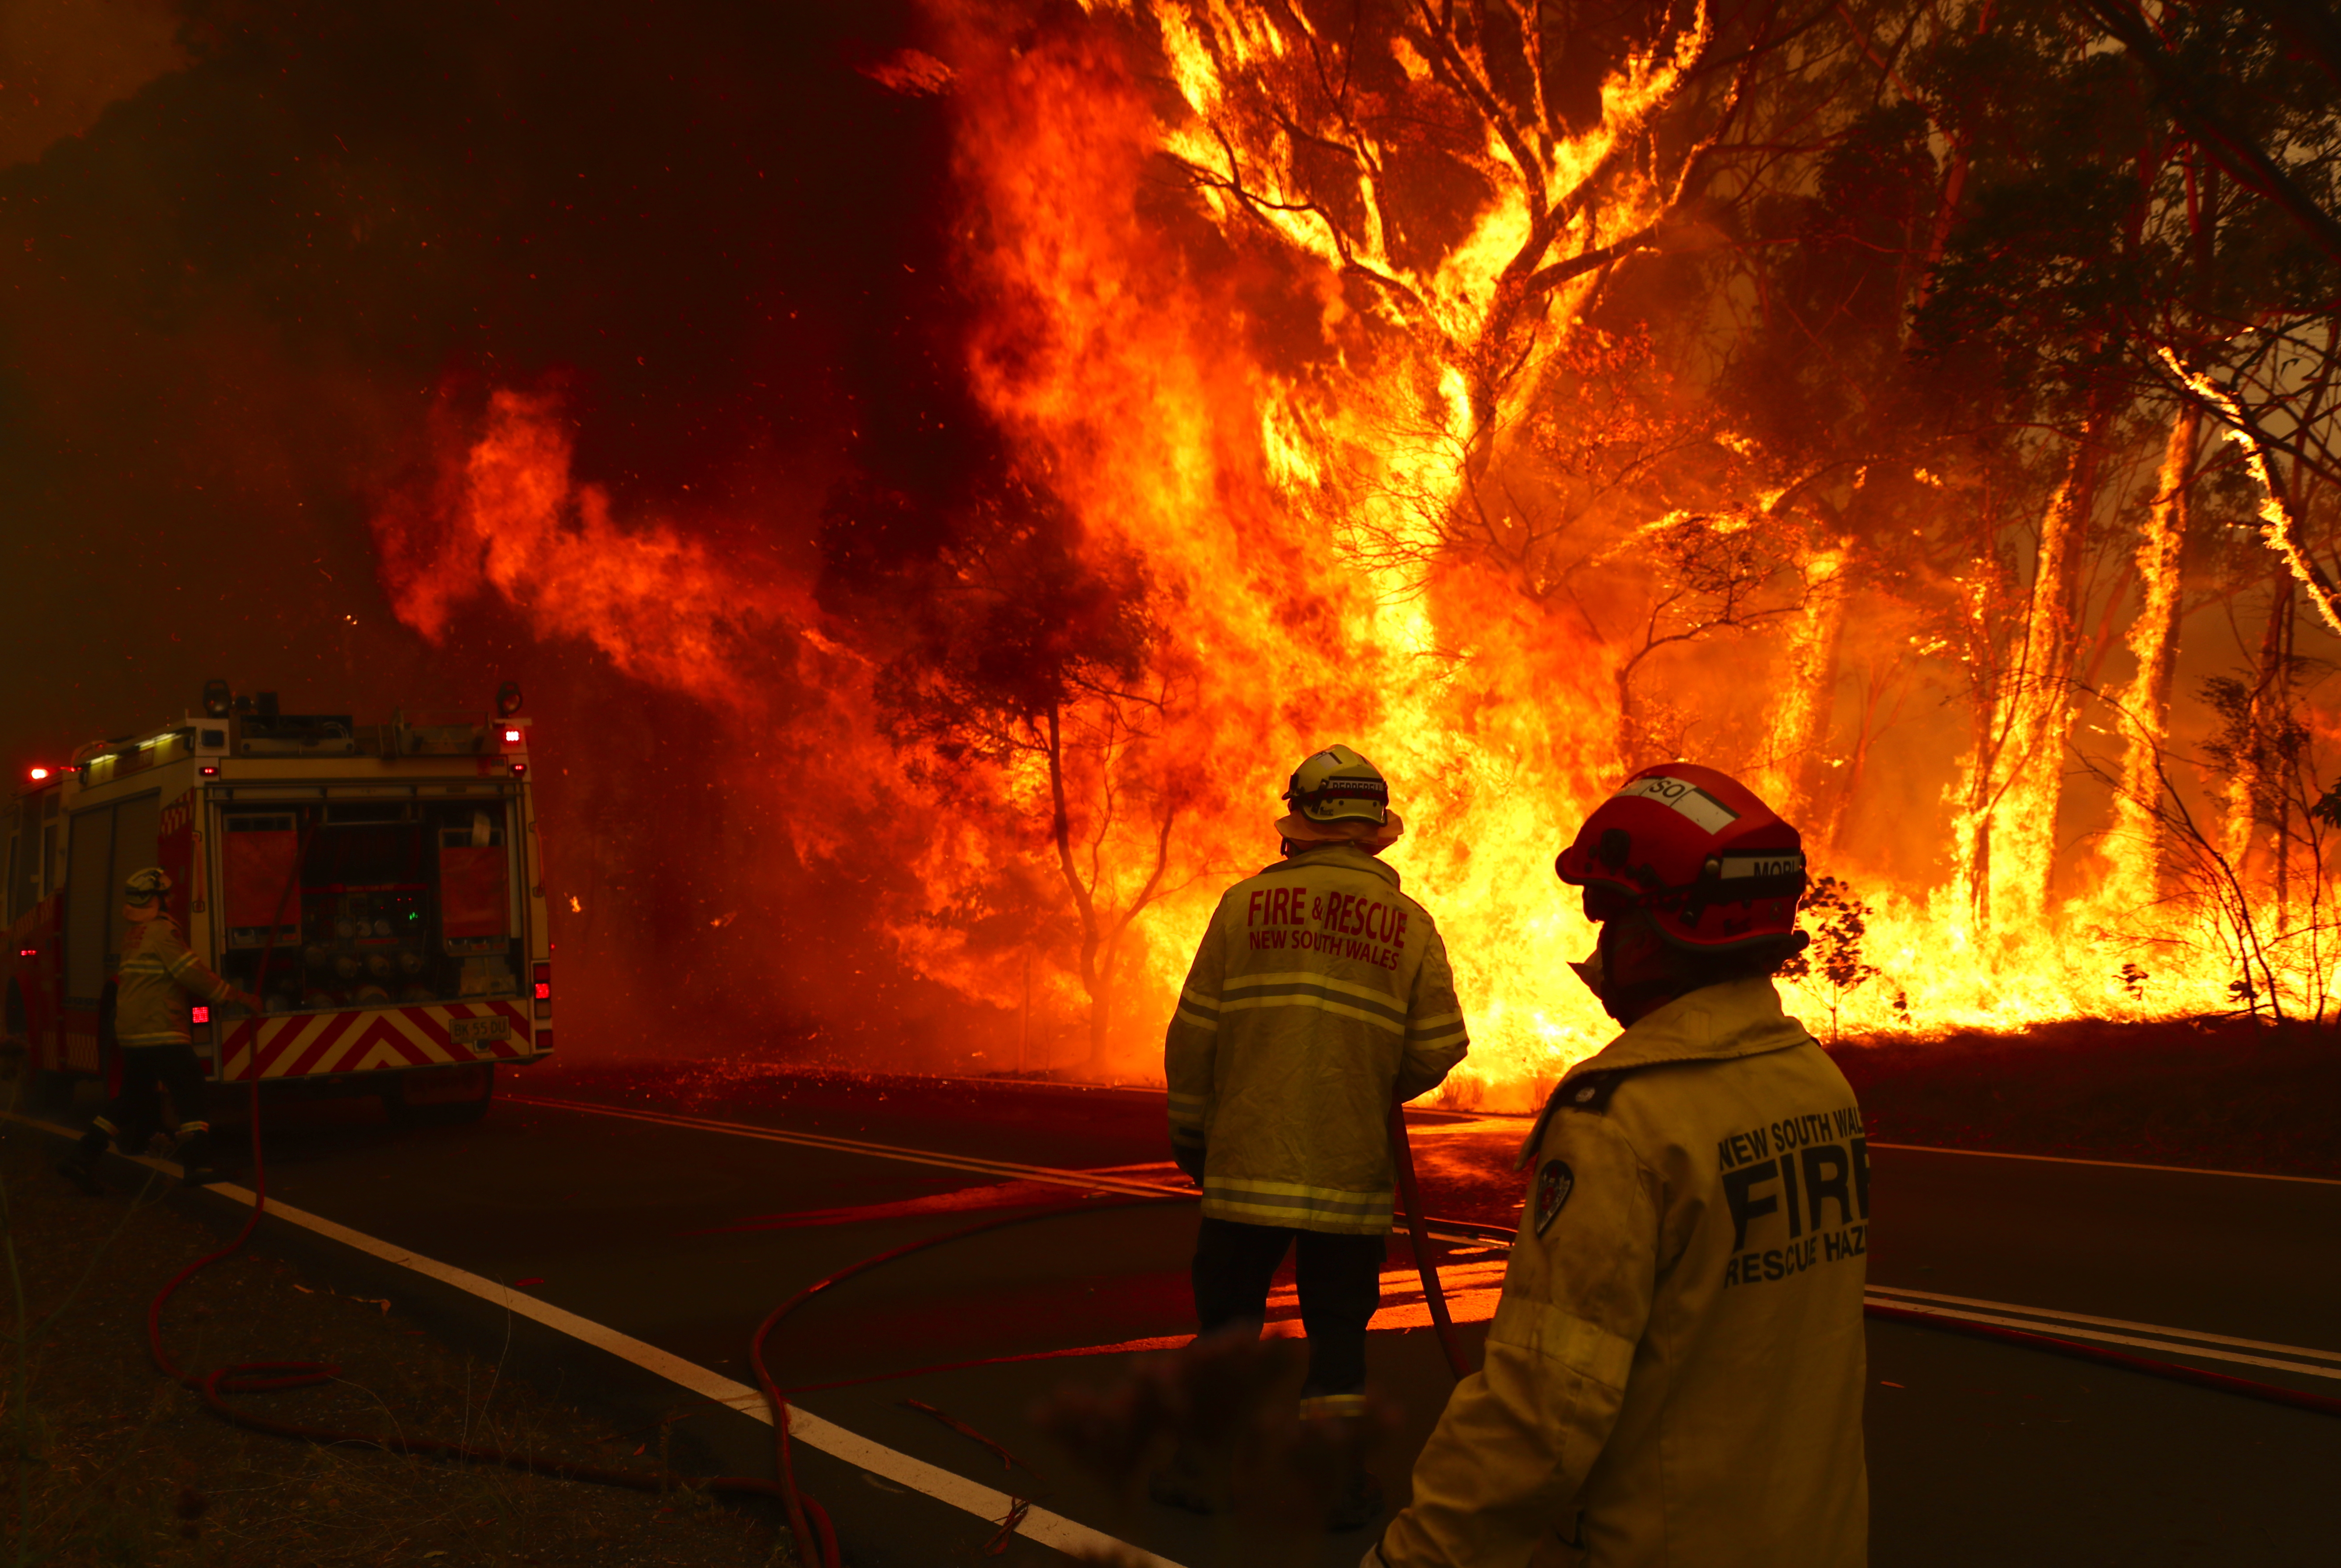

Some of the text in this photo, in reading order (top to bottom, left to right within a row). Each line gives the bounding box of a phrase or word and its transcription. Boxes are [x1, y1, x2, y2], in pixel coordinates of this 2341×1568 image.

[1649, 780, 1685, 798] SO
[1247, 888, 1408, 949] FIRE & RESCUE
[1249, 930, 1399, 971] NEW SOUTH WALES
[1718, 1128, 1769, 1171] NEW
[1771, 1113, 1833, 1152] SOUTH
[1724, 1225, 1867, 1289] RESCUE HAZ
